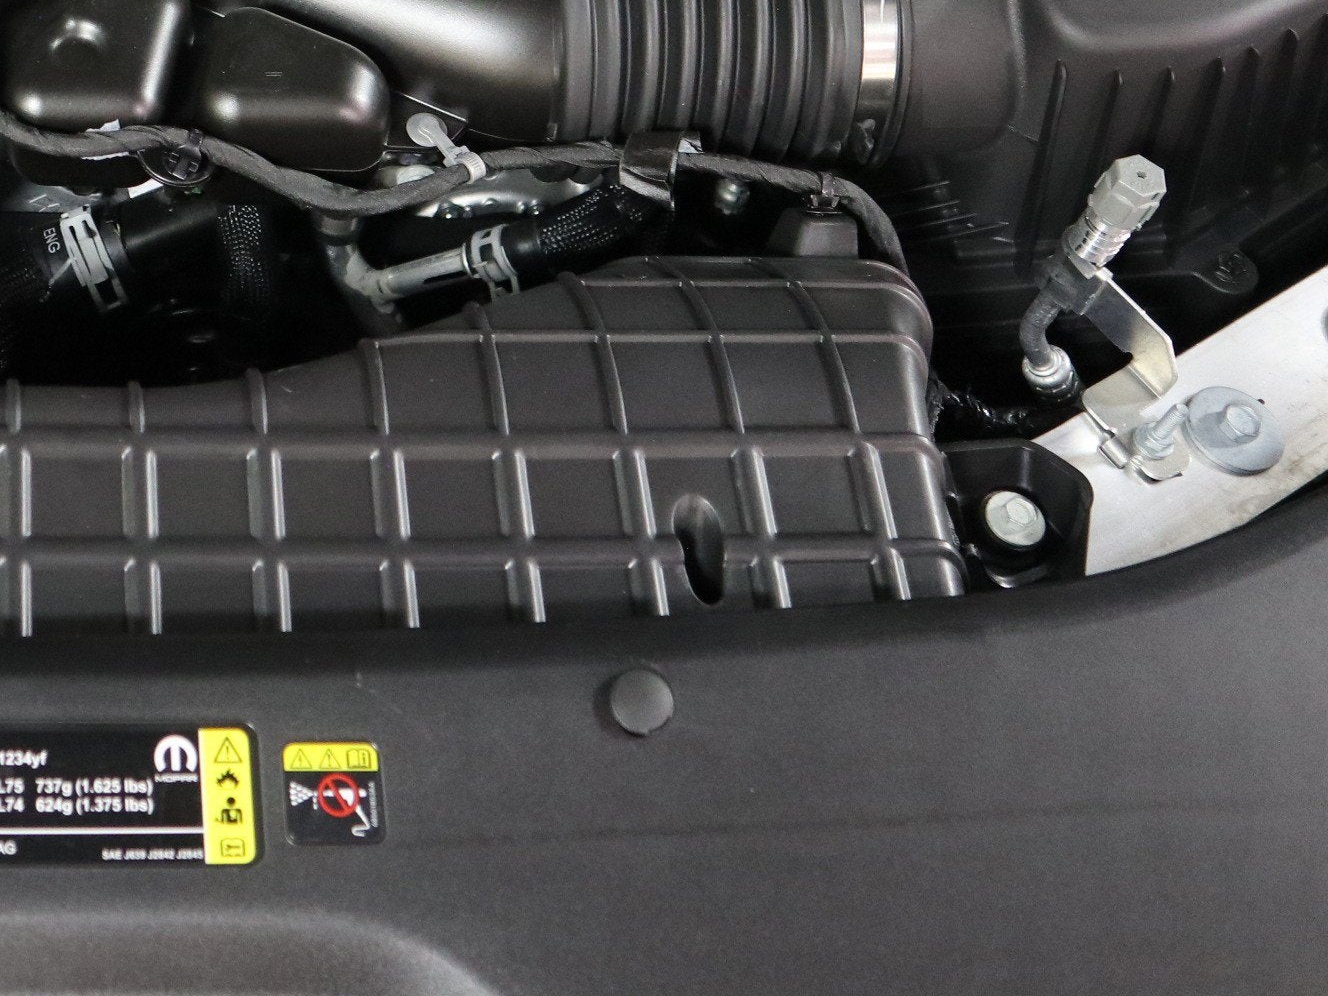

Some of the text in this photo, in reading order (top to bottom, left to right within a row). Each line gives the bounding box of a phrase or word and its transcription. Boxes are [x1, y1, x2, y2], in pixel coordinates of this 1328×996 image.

[43, 226, 61, 254] ENG
[35, 777, 73, 797] 737g
[75, 777, 122, 798] (1.625
[124, 777, 154, 797] lbs)
[155, 773, 199, 783] MOPAR
[35, 797, 73, 816] 624g
[75, 797, 122, 816] (1.375
[124, 796, 154, 816] lbs)
[102, 848, 123, 860] SAE
